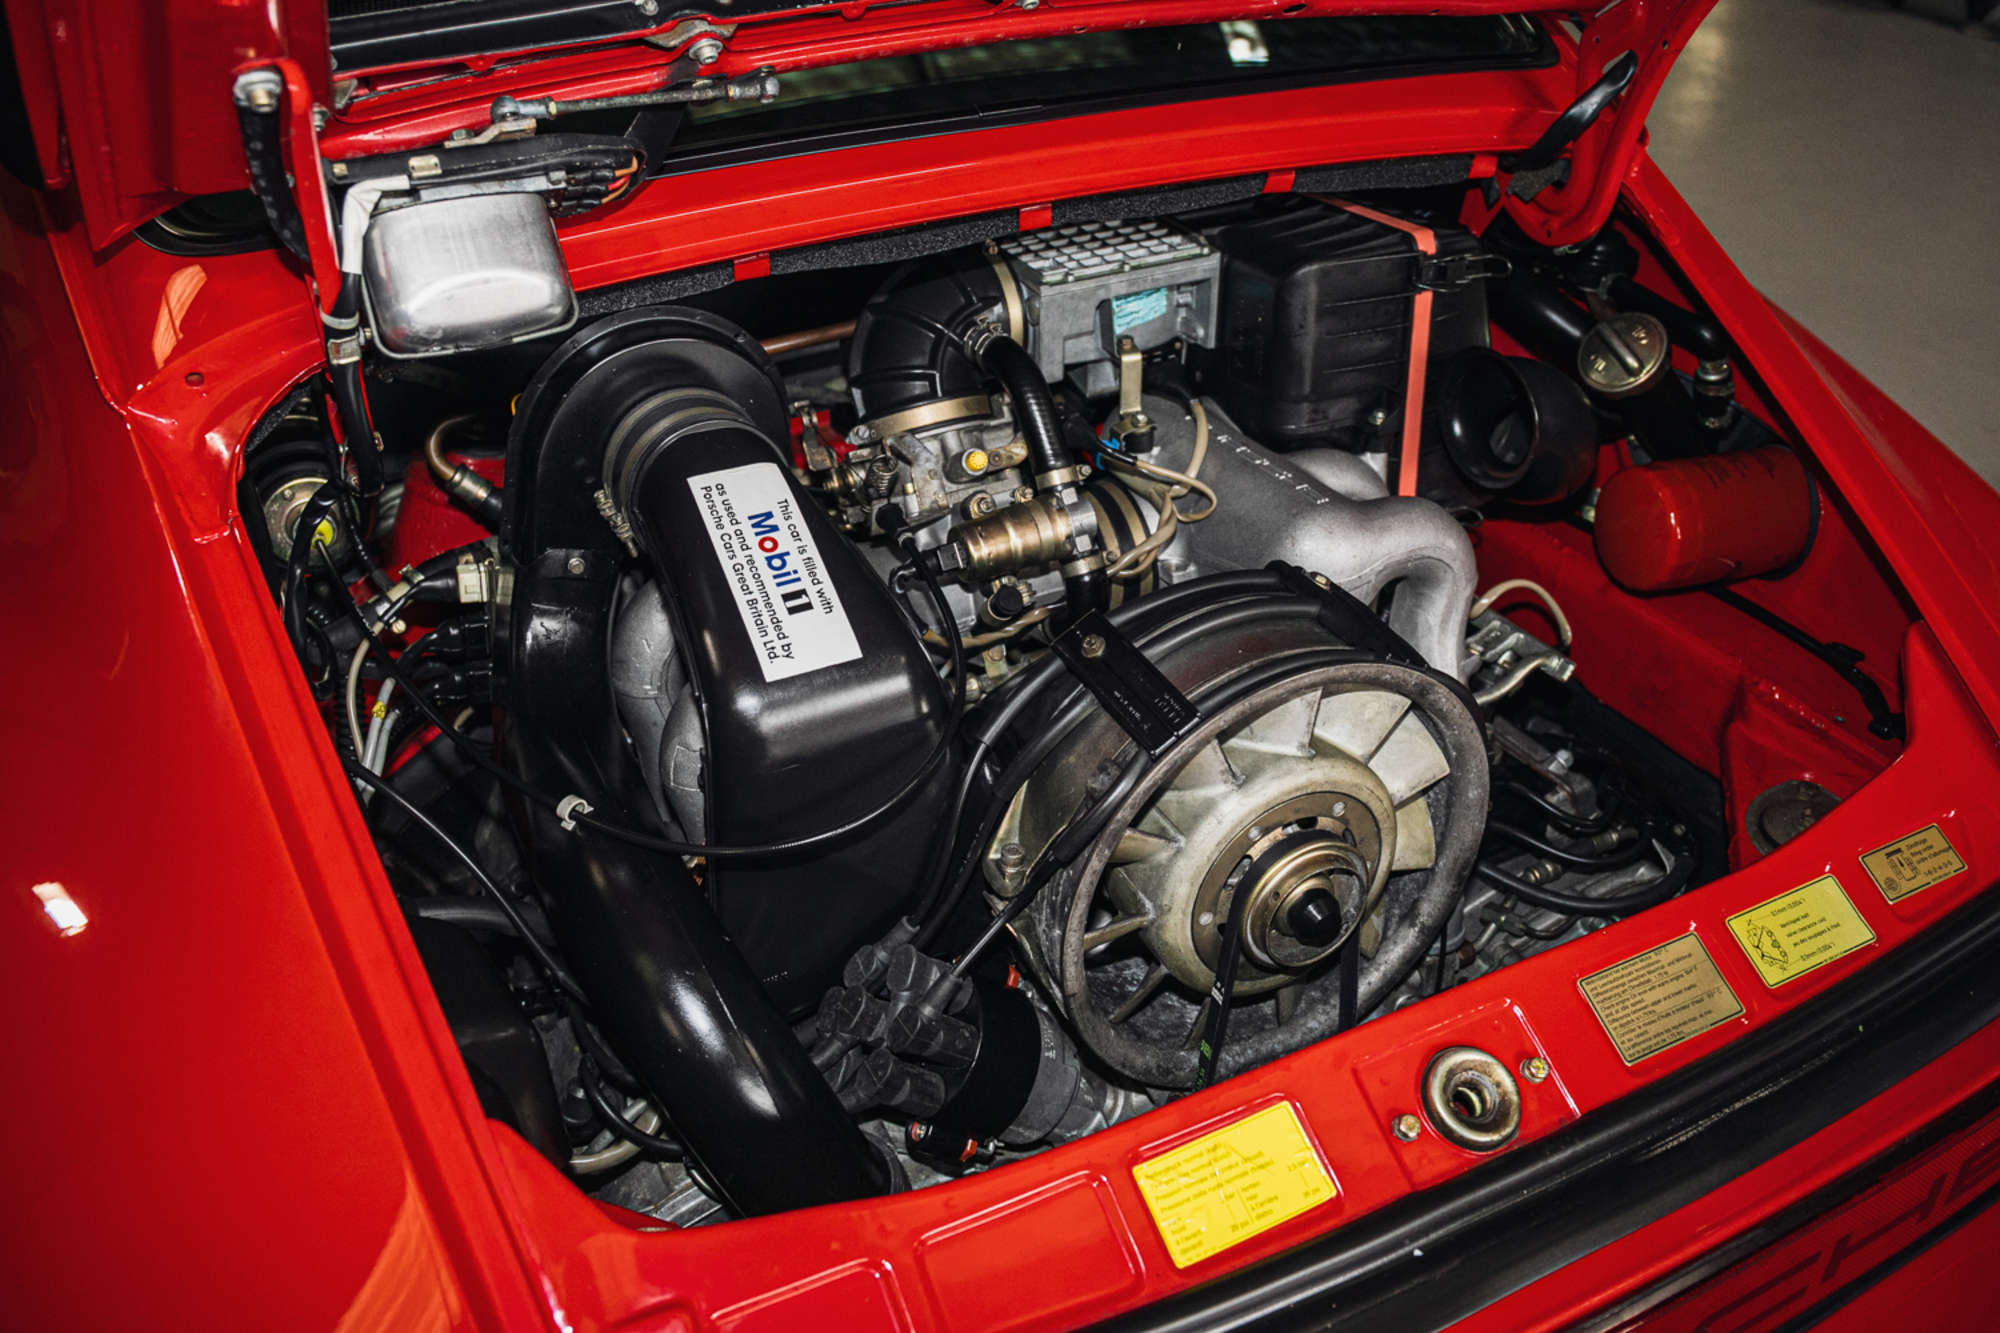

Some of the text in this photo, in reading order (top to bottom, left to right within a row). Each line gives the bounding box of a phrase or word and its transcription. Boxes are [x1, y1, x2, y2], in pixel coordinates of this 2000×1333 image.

[701, 486, 780, 663] Porsche Cars Great Britain Ltd.
[716, 483, 794, 659] as used and recommended by
[748, 510, 813, 615] Mobil 1
[777, 499, 834, 614] This car is filled with
